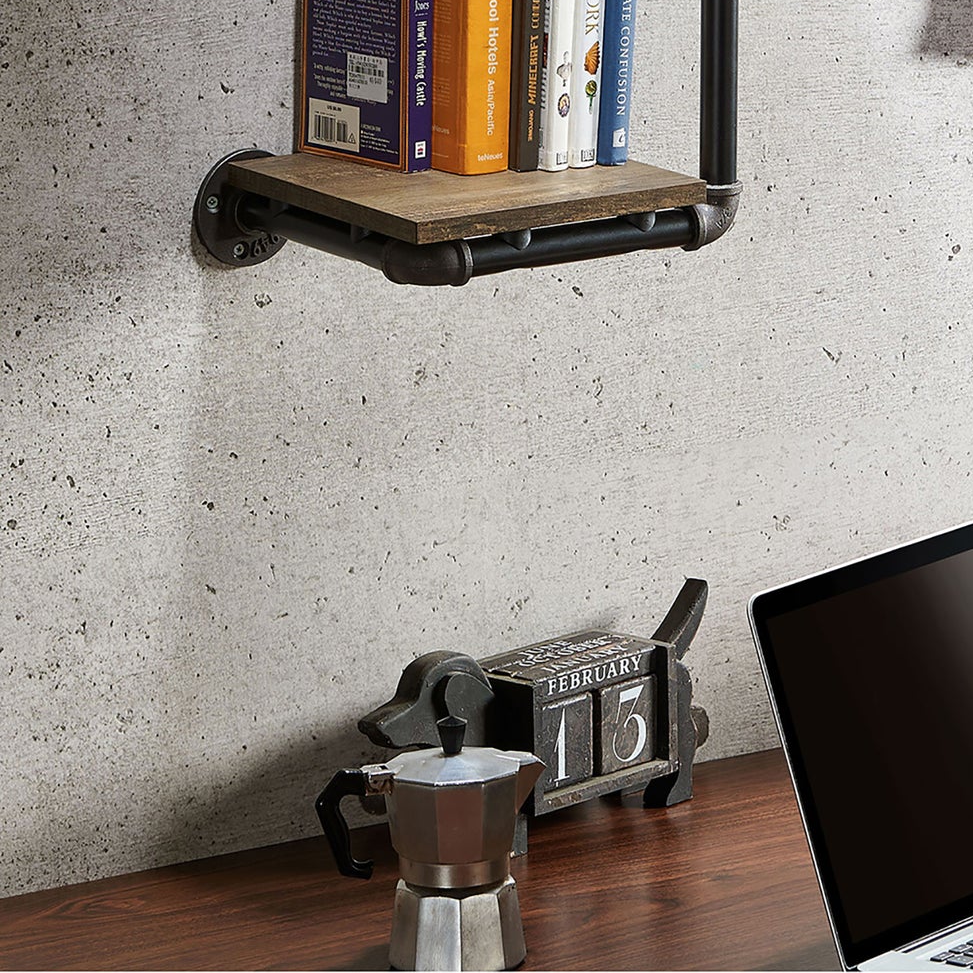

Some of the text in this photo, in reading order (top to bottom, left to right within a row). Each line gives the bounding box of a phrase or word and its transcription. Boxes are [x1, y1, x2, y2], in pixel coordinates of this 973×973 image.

[416, 20, 427, 48] Howl's
[487, 27, 499, 75] Hotels
[414, 50, 427, 80] Moving
[527, 34, 539, 105] MINECRAFT
[615, 26, 631, 117] CONFUSION
[415, 81, 427, 107] Castle
[487, 79, 495, 136] Asia/Pacific
[519, 640, 573, 659] JUNE
[541, 643, 629, 673] JANUARY
[547, 654, 643, 696] FEBRUARY
